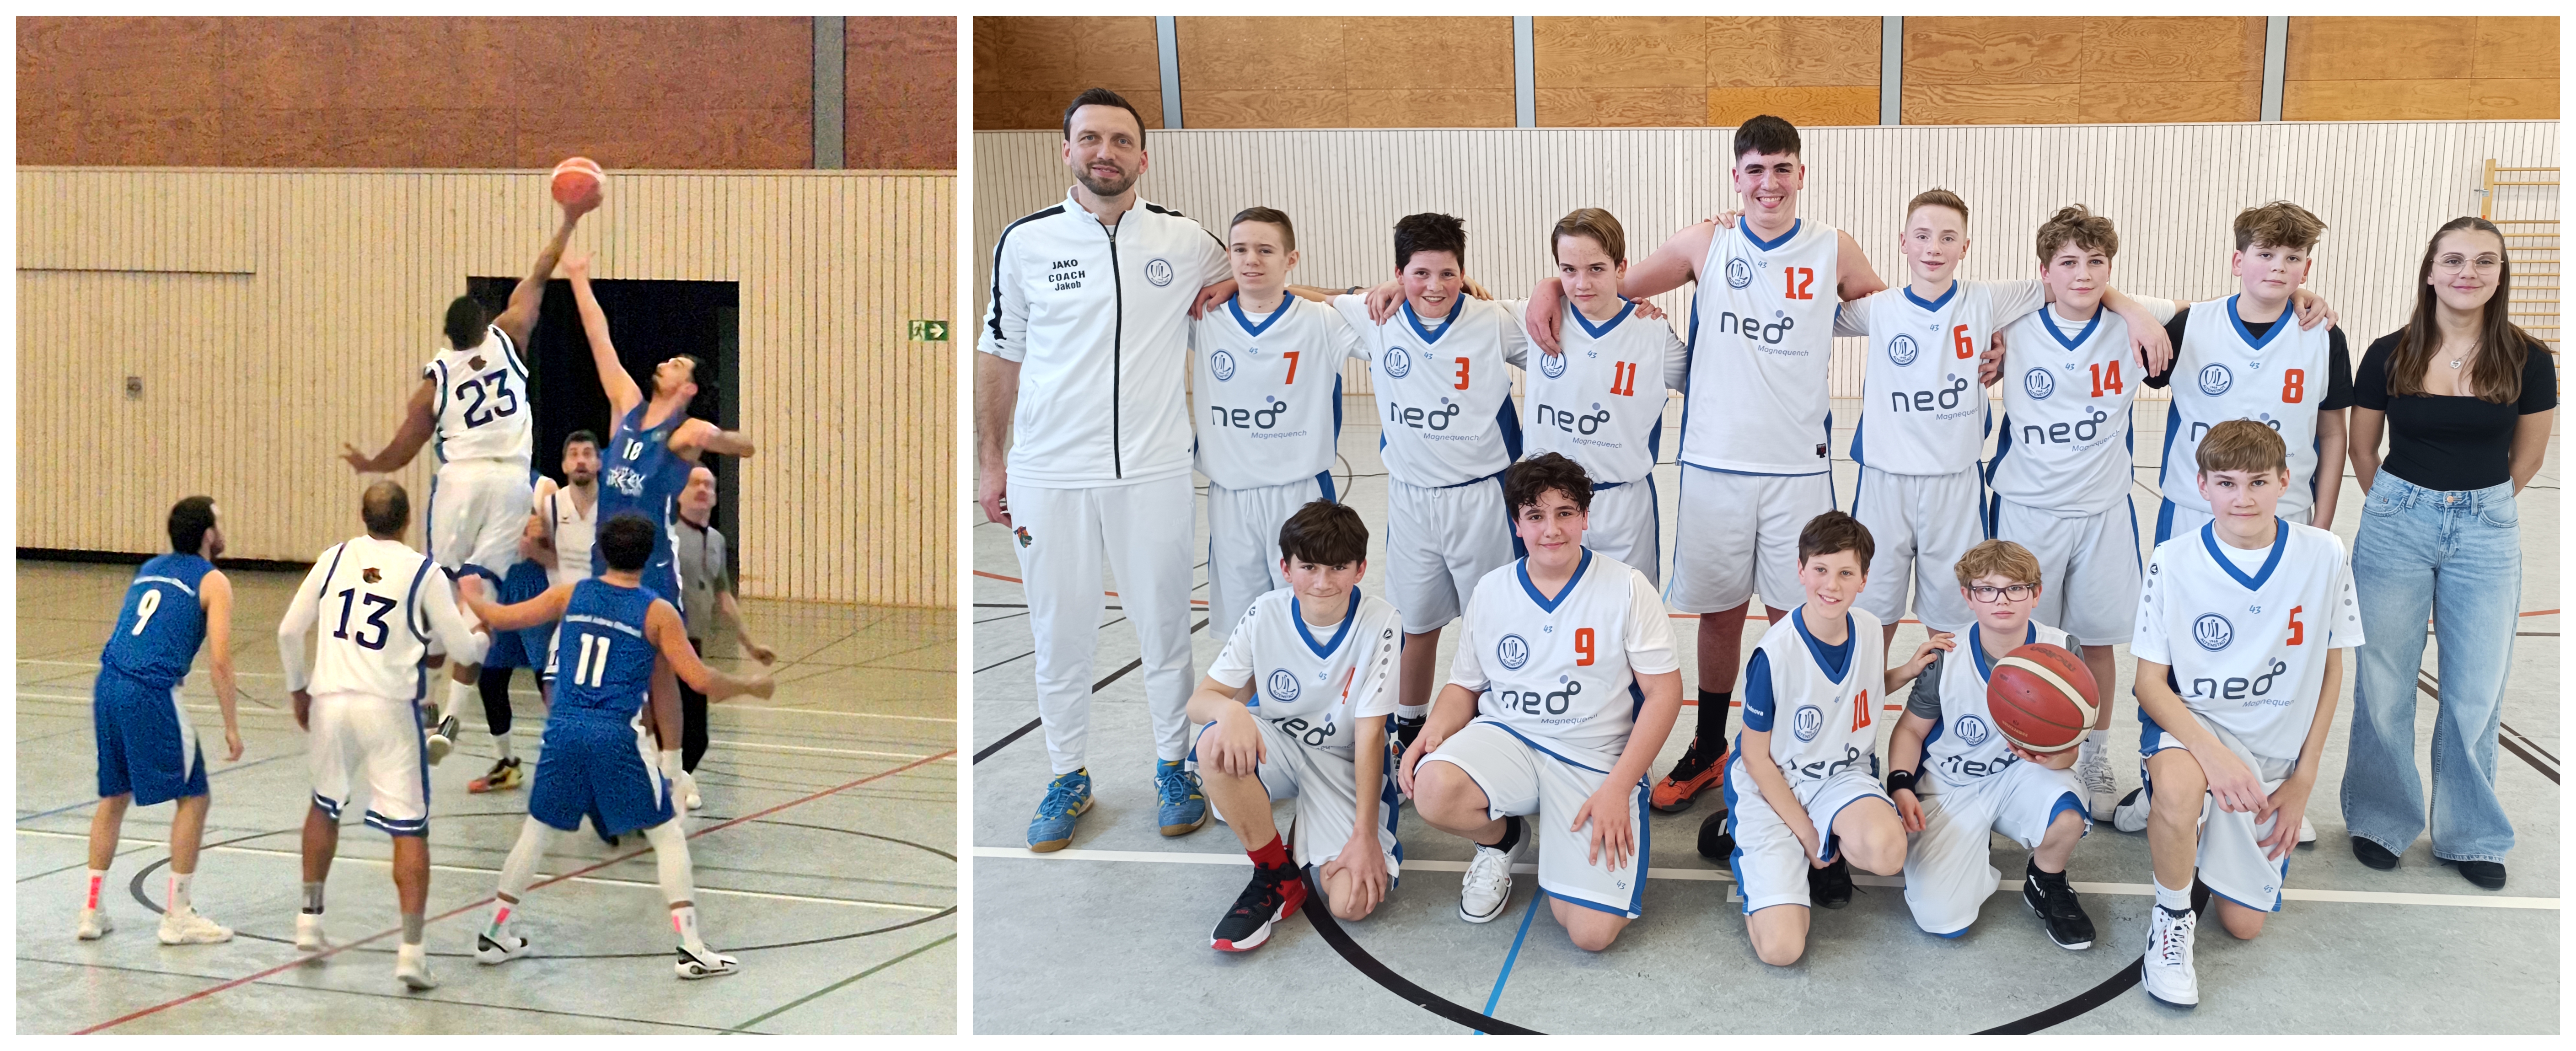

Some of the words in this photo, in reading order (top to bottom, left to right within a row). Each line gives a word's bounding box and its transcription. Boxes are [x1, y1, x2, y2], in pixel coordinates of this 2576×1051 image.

[1048, 270, 1085, 283] COACH
[1052, 259, 1078, 269] JAKO
[1055, 280, 1081, 291] Jakob
[1784, 267, 1813, 300] 12
[1721, 311, 1794, 344] neo
[1953, 324, 1973, 359] 6
[1758, 345, 1809, 356] Magnequench
[1283, 351, 1300, 385] 7
[1454, 357, 1470, 390] 3
[1610, 361, 1636, 397] 11
[2089, 360, 2123, 397] 14
[456, 369, 517, 429] 23
[1892, 378, 1968, 412] neo
[2281, 369, 2304, 403] 8
[1212, 401, 1287, 429] neo
[1391, 402, 1460, 430] neo
[1537, 404, 1610, 435] neo
[1936, 407, 1978, 420] Magnequenc
[2023, 411, 2107, 444] neo
[623, 438, 644, 460] 18
[1251, 430, 1307, 439] Magnequench
[1423, 433, 1479, 441] Magnequench
[1572, 437, 1622, 448] Magnequench
[132, 589, 161, 635] 9
[333, 588, 397, 650] 13
[2249, 605, 2261, 614] 43
[1544, 625, 1553, 633] 43
[2286, 605, 2303, 646] 5
[1575, 627, 1594, 666] 9
[2200, 638, 2227, 647] ALTENSTADT
[574, 633, 611, 687] 11
[1503, 658, 1524, 666] ALTENSTADT
[2030, 646, 2076, 672] molten
[1319, 671, 1327, 680] 43
[2194, 661, 2286, 699] neo
[1501, 681, 1581, 715] neo
[1852, 688, 1871, 733] 10
[2243, 699, 2294, 707] Magnequen
[1617, 879, 1626, 890] 43
[2264, 885, 2273, 893] 43
